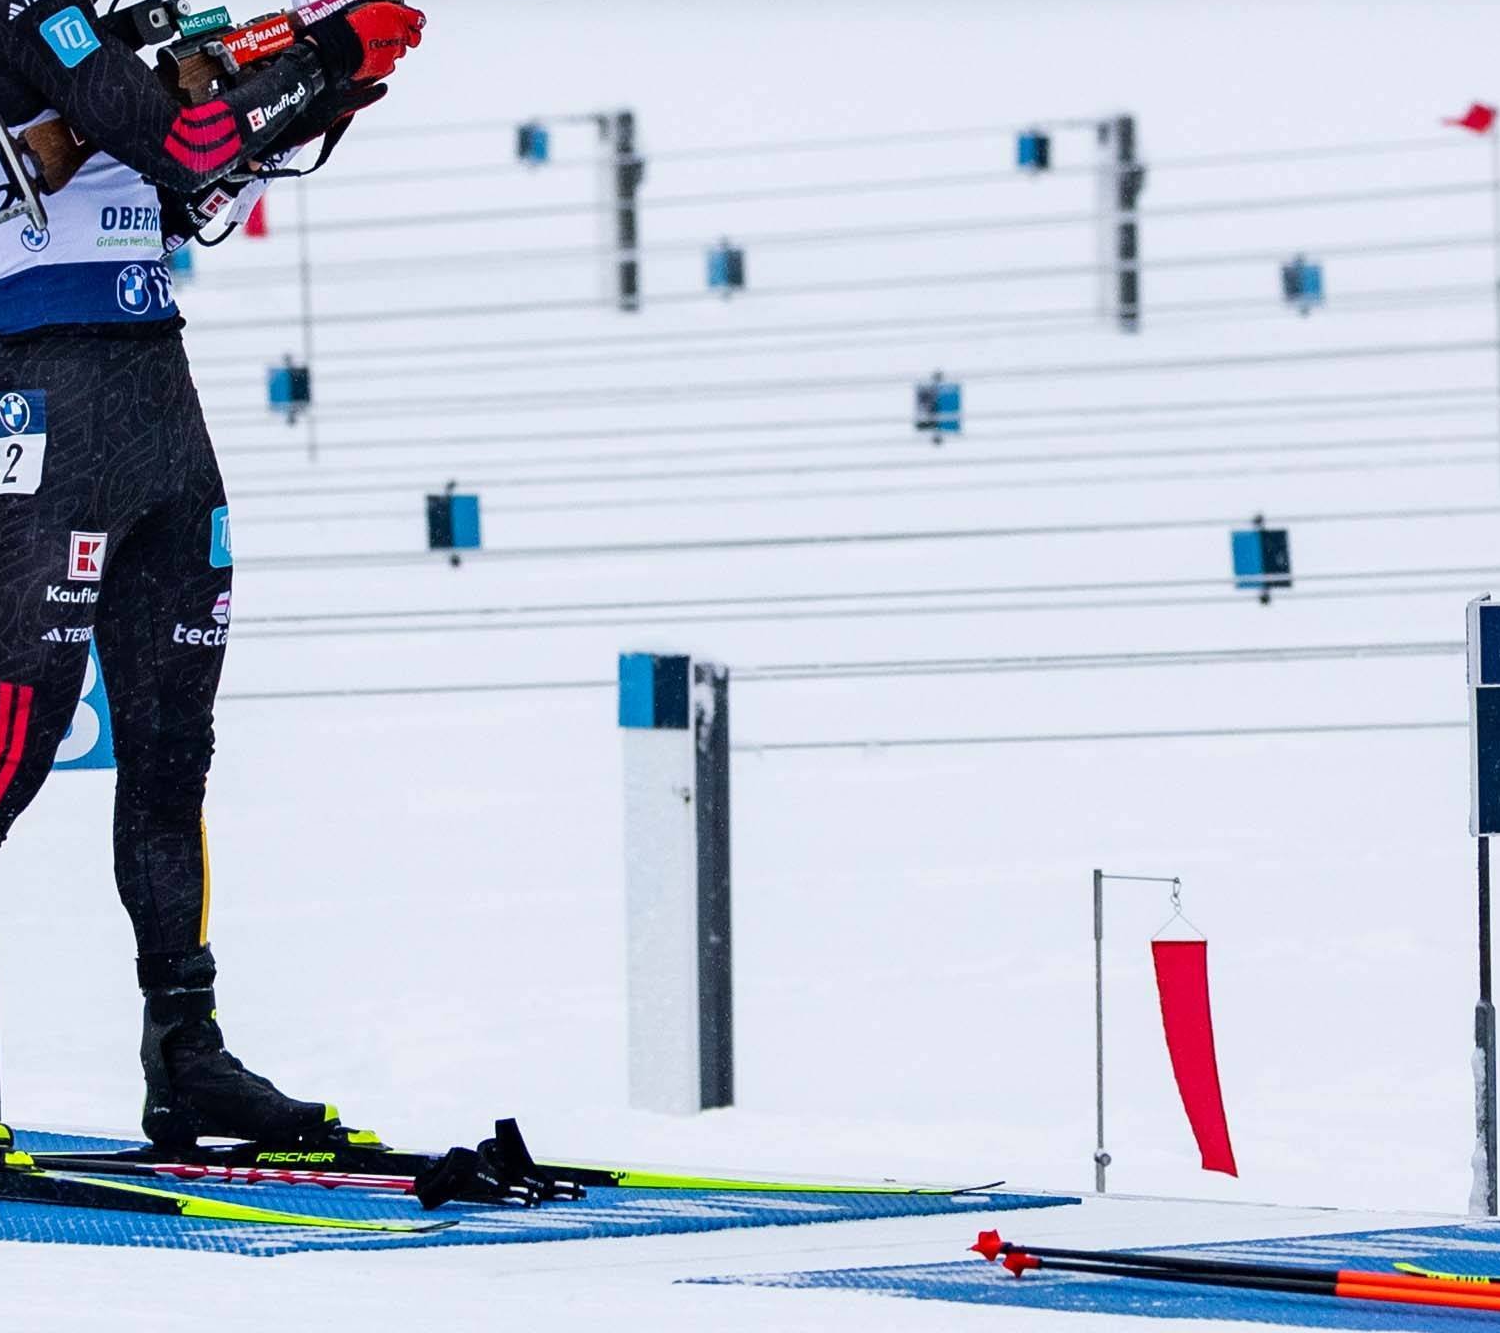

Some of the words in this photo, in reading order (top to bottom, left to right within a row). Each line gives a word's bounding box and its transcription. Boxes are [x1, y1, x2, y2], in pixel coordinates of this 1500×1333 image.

[50, 16, 93, 50] TQ
[179, 10, 229, 31] M4Energy
[227, 21, 291, 52] VIESSMANN
[264, 82, 306, 120] Kauflad
[101, 206, 160, 231] OBERH
[2, 443, 23, 484] 2
[46, 585, 99, 603] Kaufla
[256, 1152, 335, 1164] FISCHER
